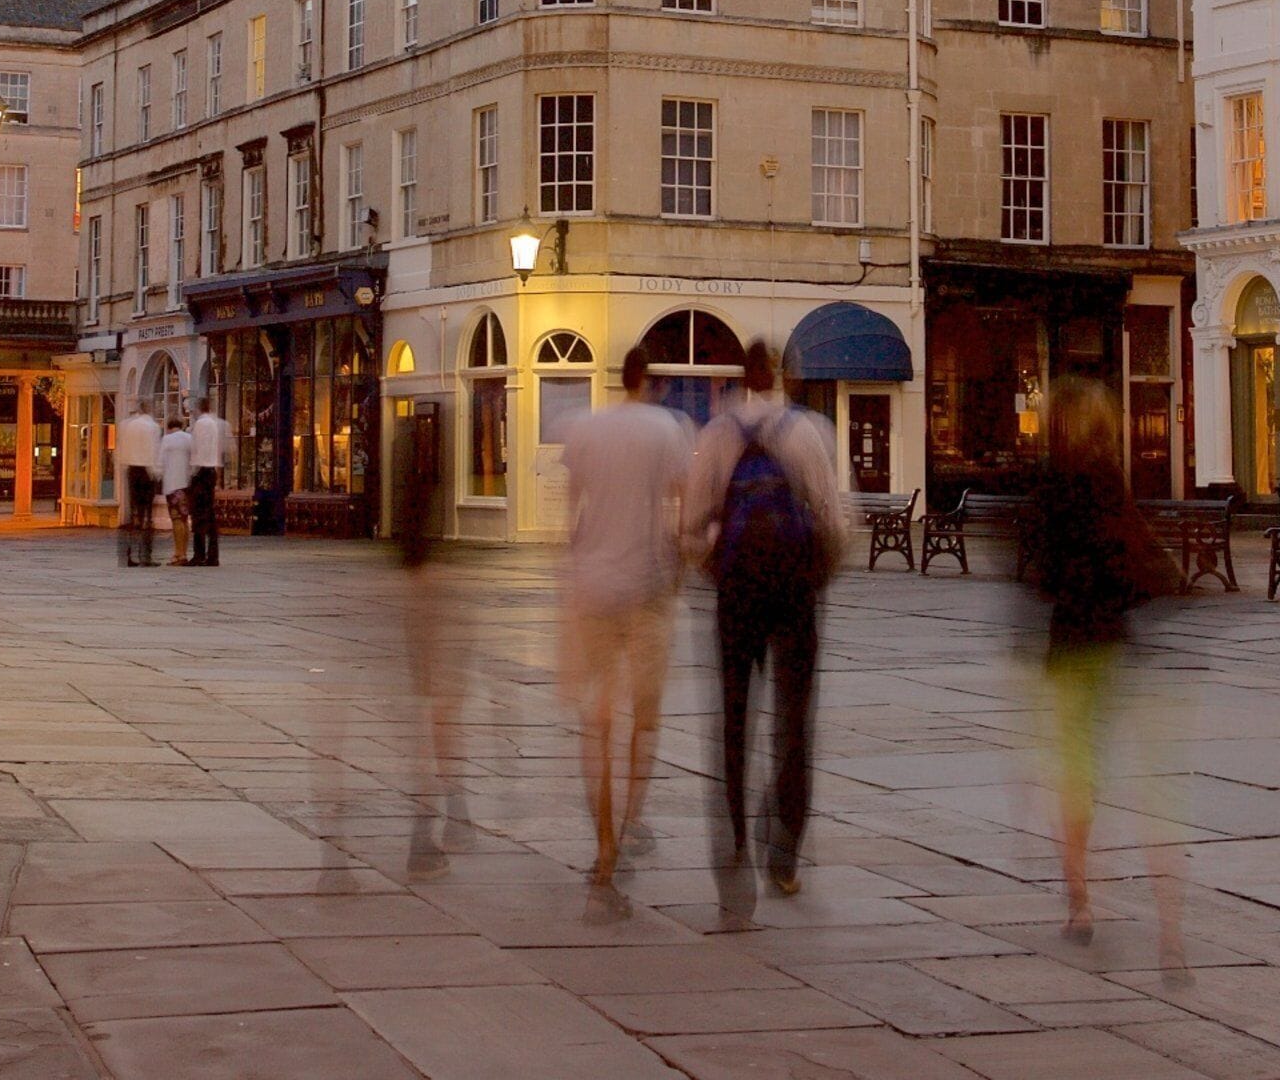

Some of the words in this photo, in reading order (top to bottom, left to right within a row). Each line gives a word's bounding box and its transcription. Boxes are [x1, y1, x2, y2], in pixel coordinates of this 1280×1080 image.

[481, 281, 505, 295] CORY
[639, 278, 684, 292] JODY
[695, 280, 744, 294] CORY
